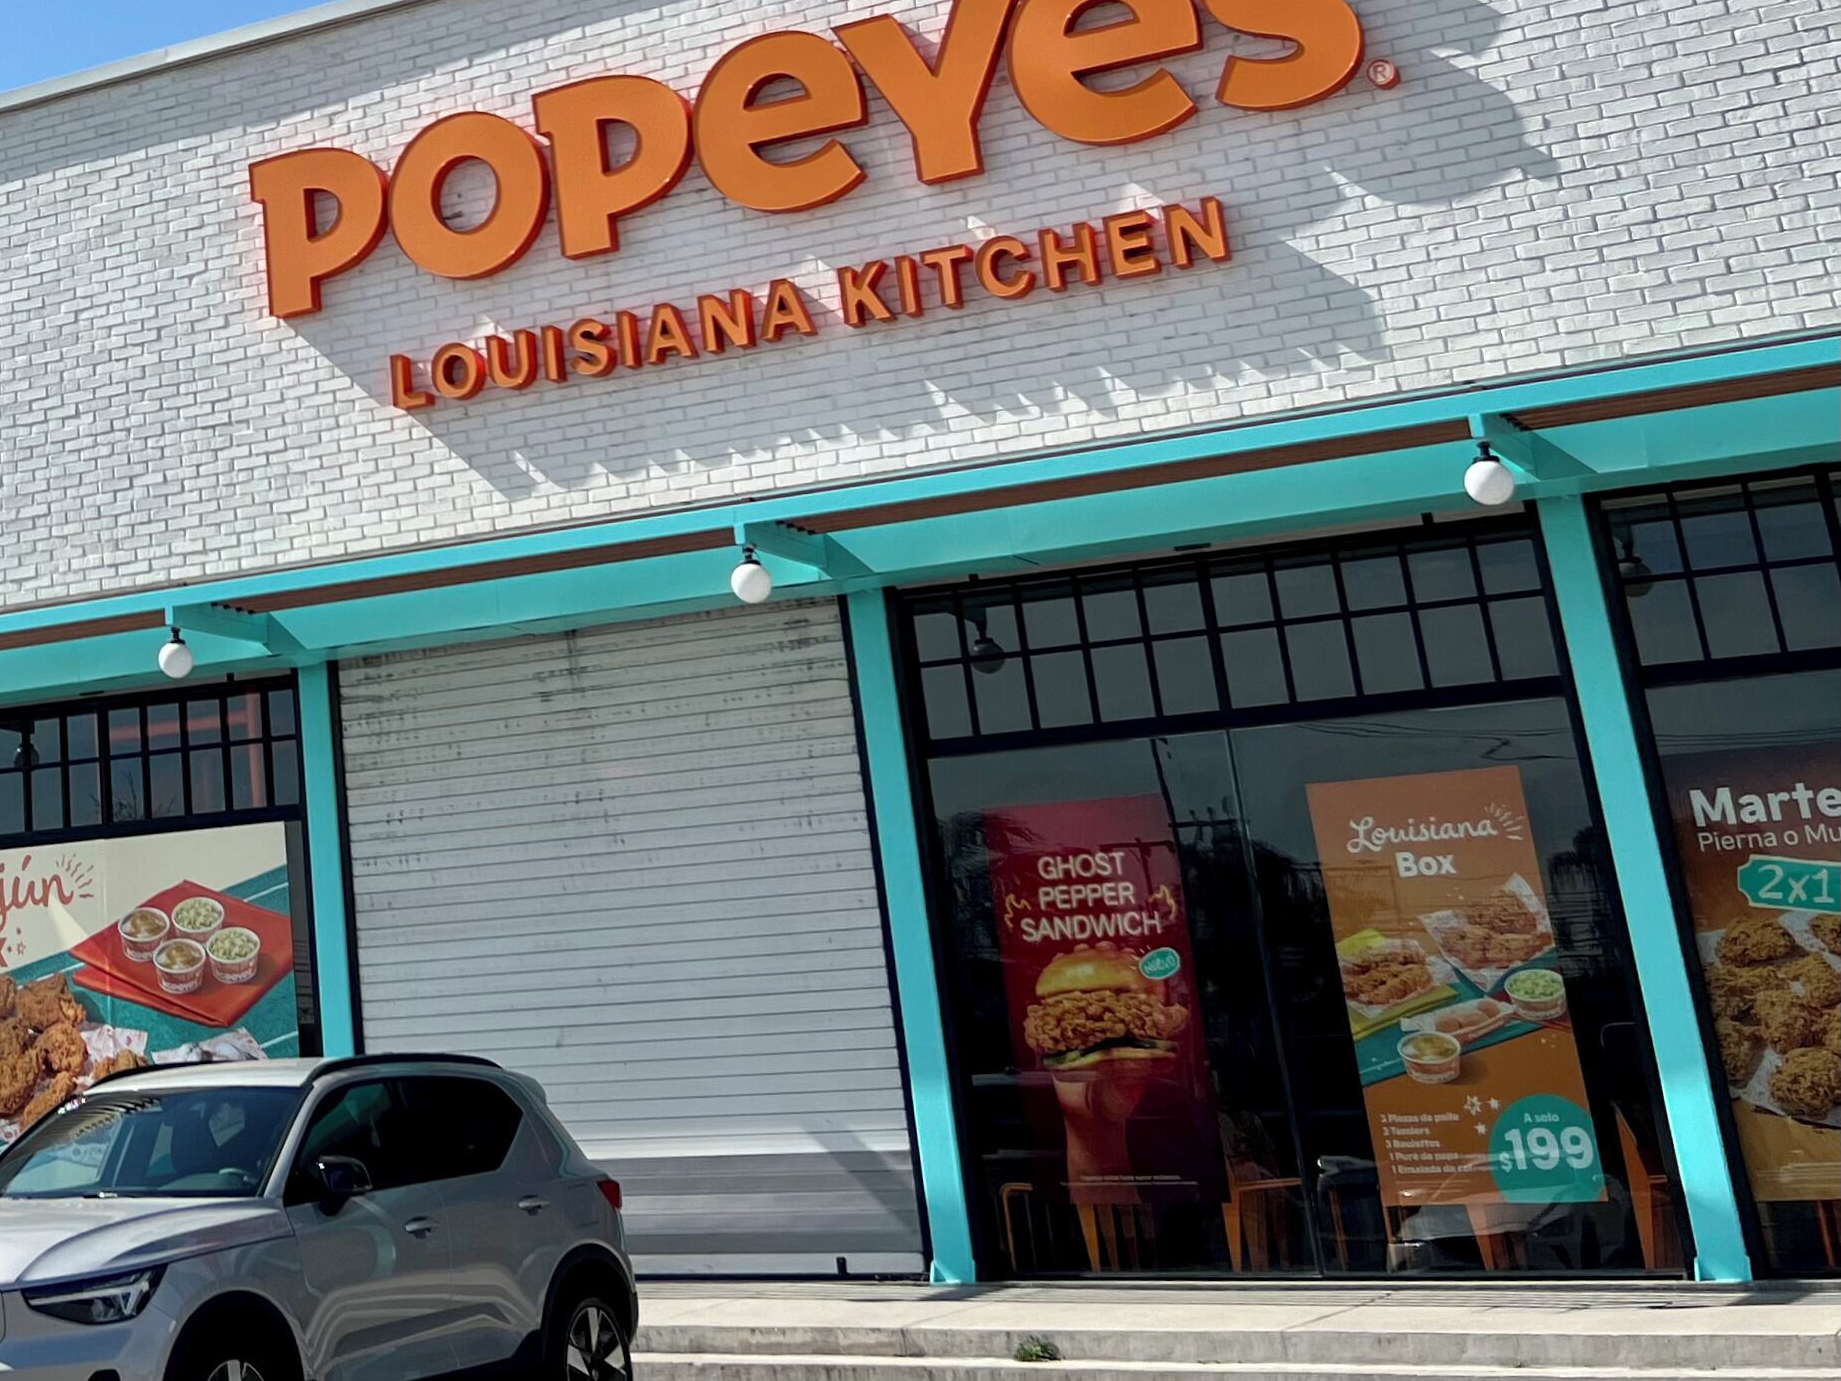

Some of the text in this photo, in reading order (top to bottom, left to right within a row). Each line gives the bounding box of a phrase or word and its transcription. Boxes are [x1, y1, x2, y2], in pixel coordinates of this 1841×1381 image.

[389, 195, 1231, 410] LOUISIANA KITCHEN
[1346, 816, 1498, 853] Louisiana
[1697, 830, 1777, 852] Pierna
[1783, 830, 1798, 846] o
[1037, 851, 1125, 880] GHOST
[1395, 851, 1456, 878] Box
[1038, 881, 1136, 911] PEPPER
[1758, 864, 1835, 904] 2x1
[1020, 910, 1163, 943] SANDWICH
[1523, 1112, 1560, 1123] A solo
[1498, 1126, 1595, 1173] $199
